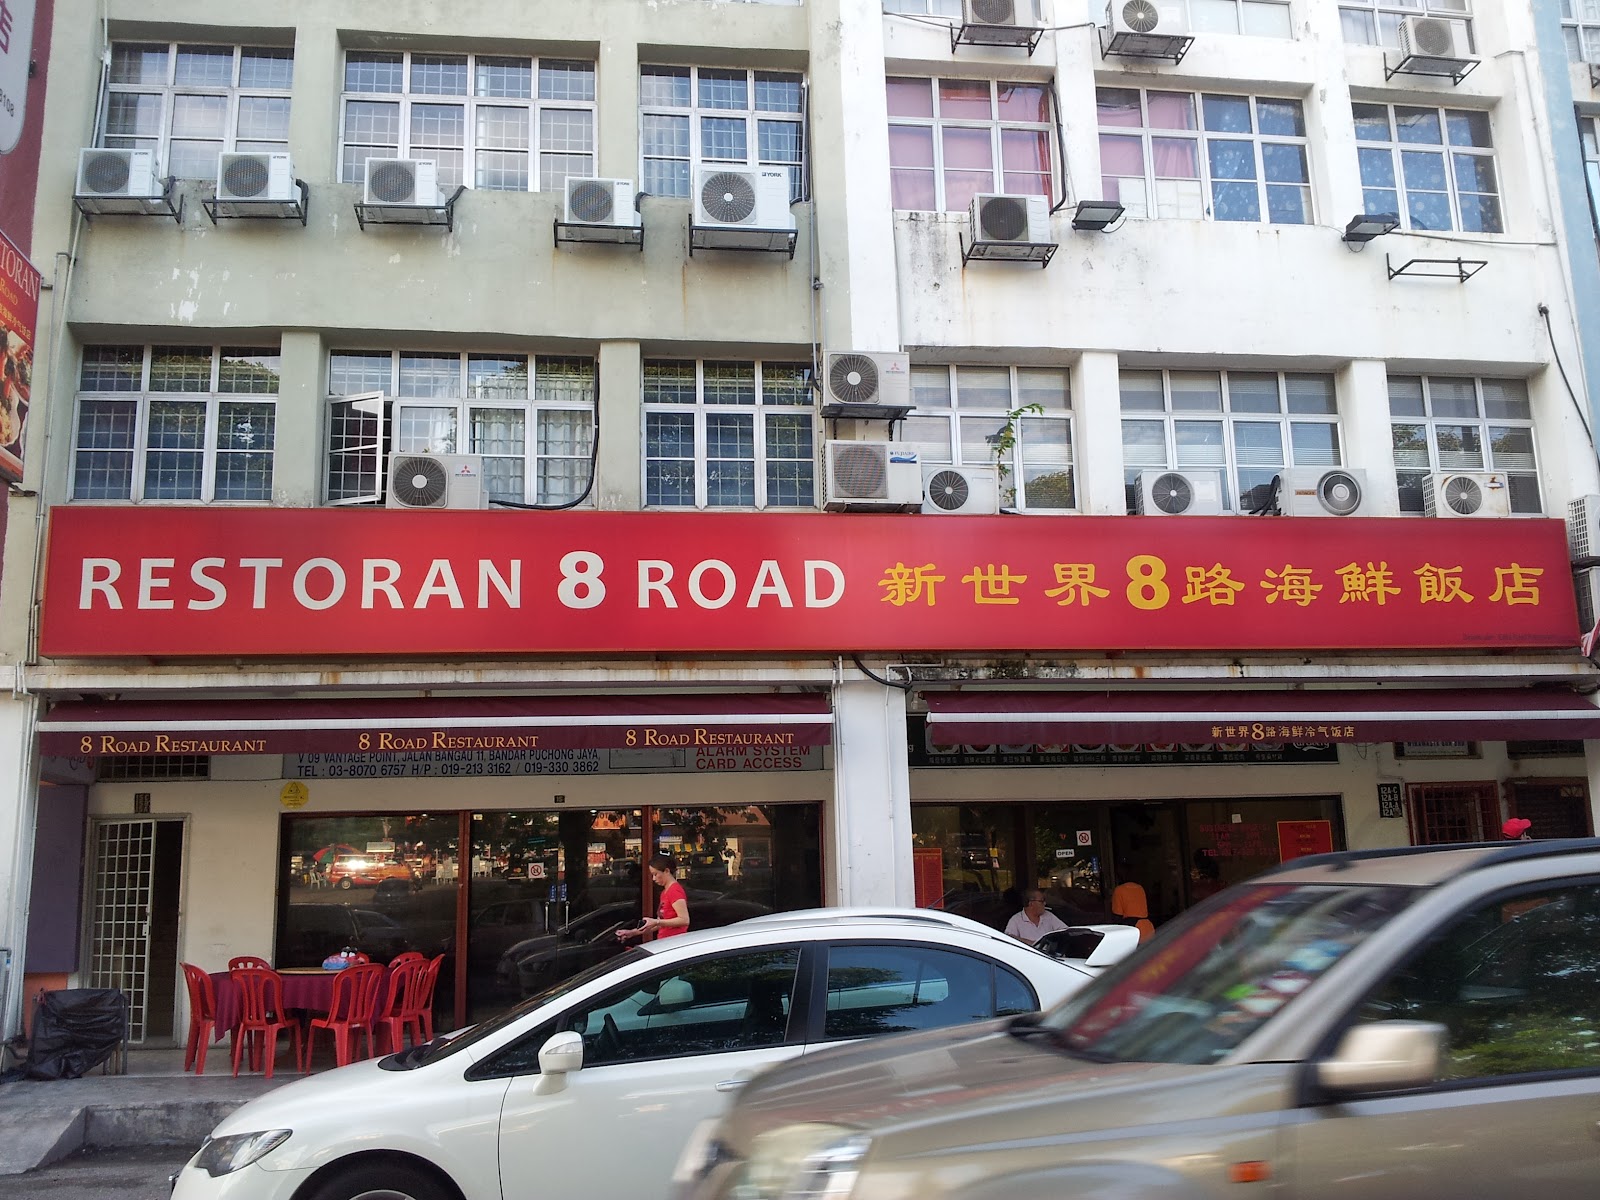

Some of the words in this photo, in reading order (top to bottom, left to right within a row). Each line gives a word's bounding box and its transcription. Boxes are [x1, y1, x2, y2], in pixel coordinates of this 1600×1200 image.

[0, 237, 39, 302] TORAN
[78, 557, 522, 611] RESTORAN
[557, 551, 606, 610] 8
[637, 558, 846, 610] ROAD
[80, 735, 93, 754] 8
[358, 732, 371, 751] 8
[625, 729, 637, 746] 8
[324, 752, 366, 764] VANTAGE
[401, 751, 432, 763] JALAN
[435, 750, 473, 762] BANGAU
[489, 749, 526, 761] BANDAR
[529, 749, 574, 761] PUCHONG
[695, 745, 748, 757] ALARM
[753, 745, 811, 756] SYSTEM
[328, 764, 377, 777] 03-8070
[380, 764, 406, 776] 6757
[441, 763, 484, 775] 019-213
[487, 762, 511, 774] 3162
[524, 761, 569, 773] 019-330
[573, 761, 599, 773] 3862
[696, 758, 737, 770] CARD
[743, 757, 802, 769] ACCESS
